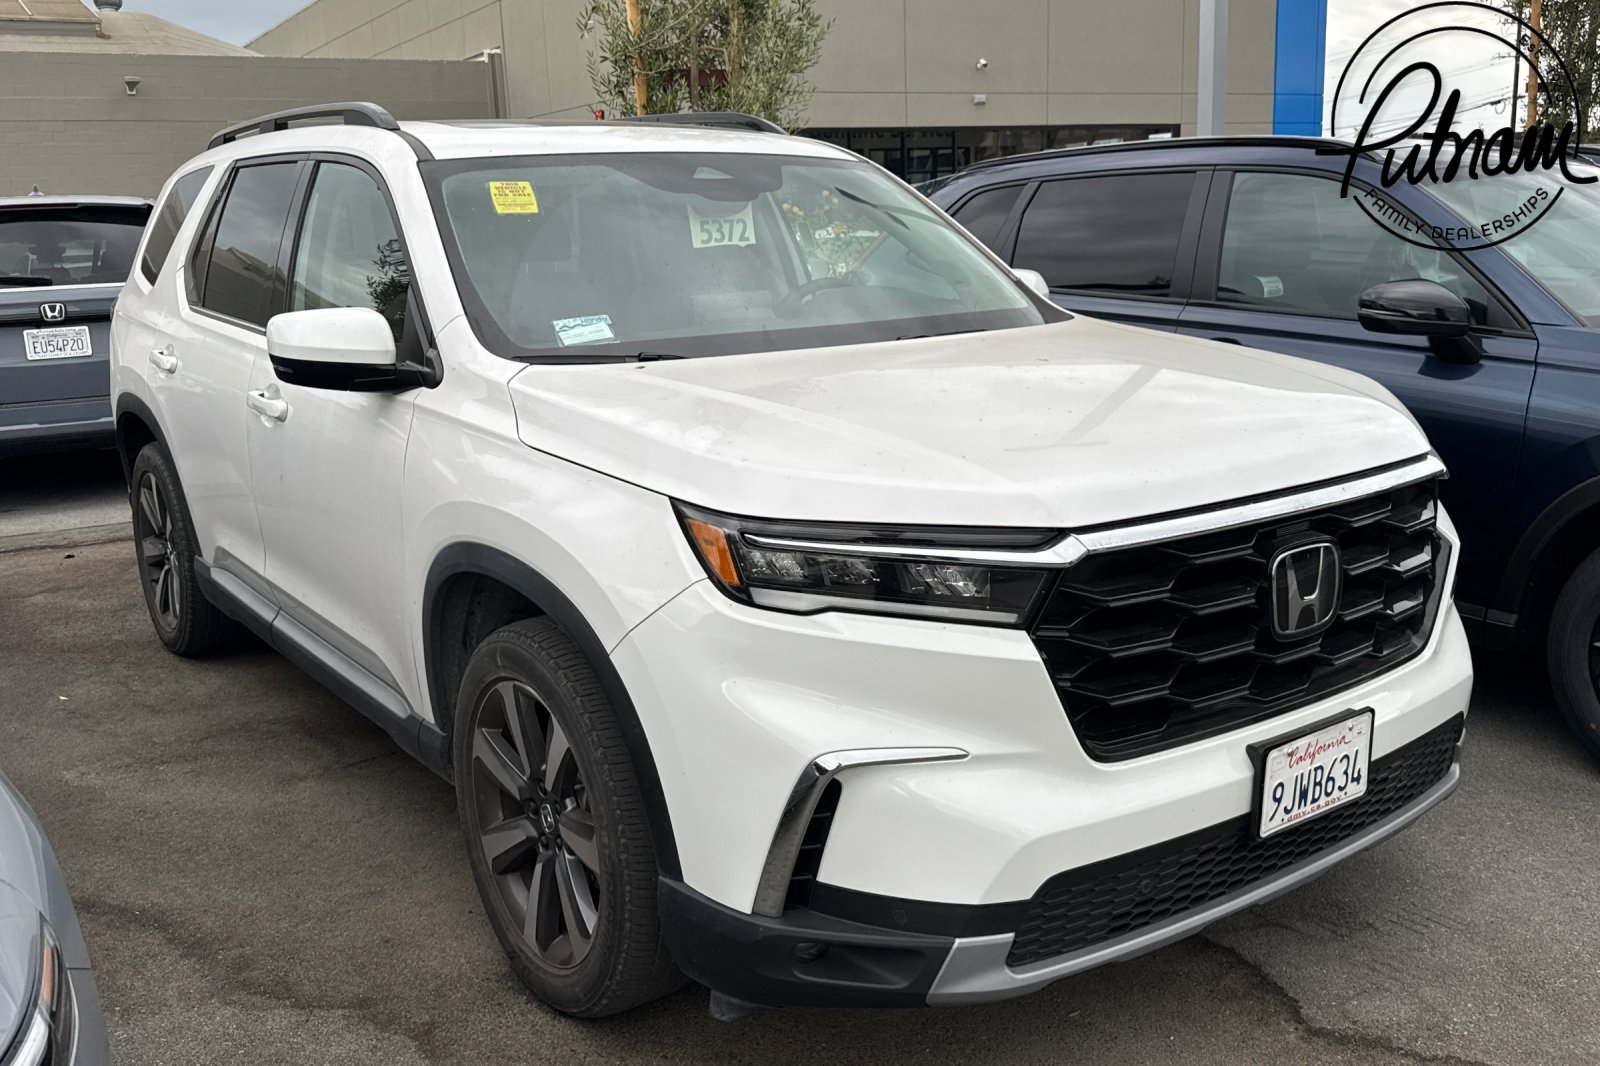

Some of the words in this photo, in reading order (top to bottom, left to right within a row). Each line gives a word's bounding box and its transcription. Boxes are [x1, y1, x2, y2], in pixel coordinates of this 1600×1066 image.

[700, 217, 751, 246] 5372
[32, 337, 84, 355] EU54P20
[1288, 735, 1352, 769] California
[1268, 747, 1362, 823] 9JWB634
[1286, 796, 1342, 822] dmv.ca.gov
